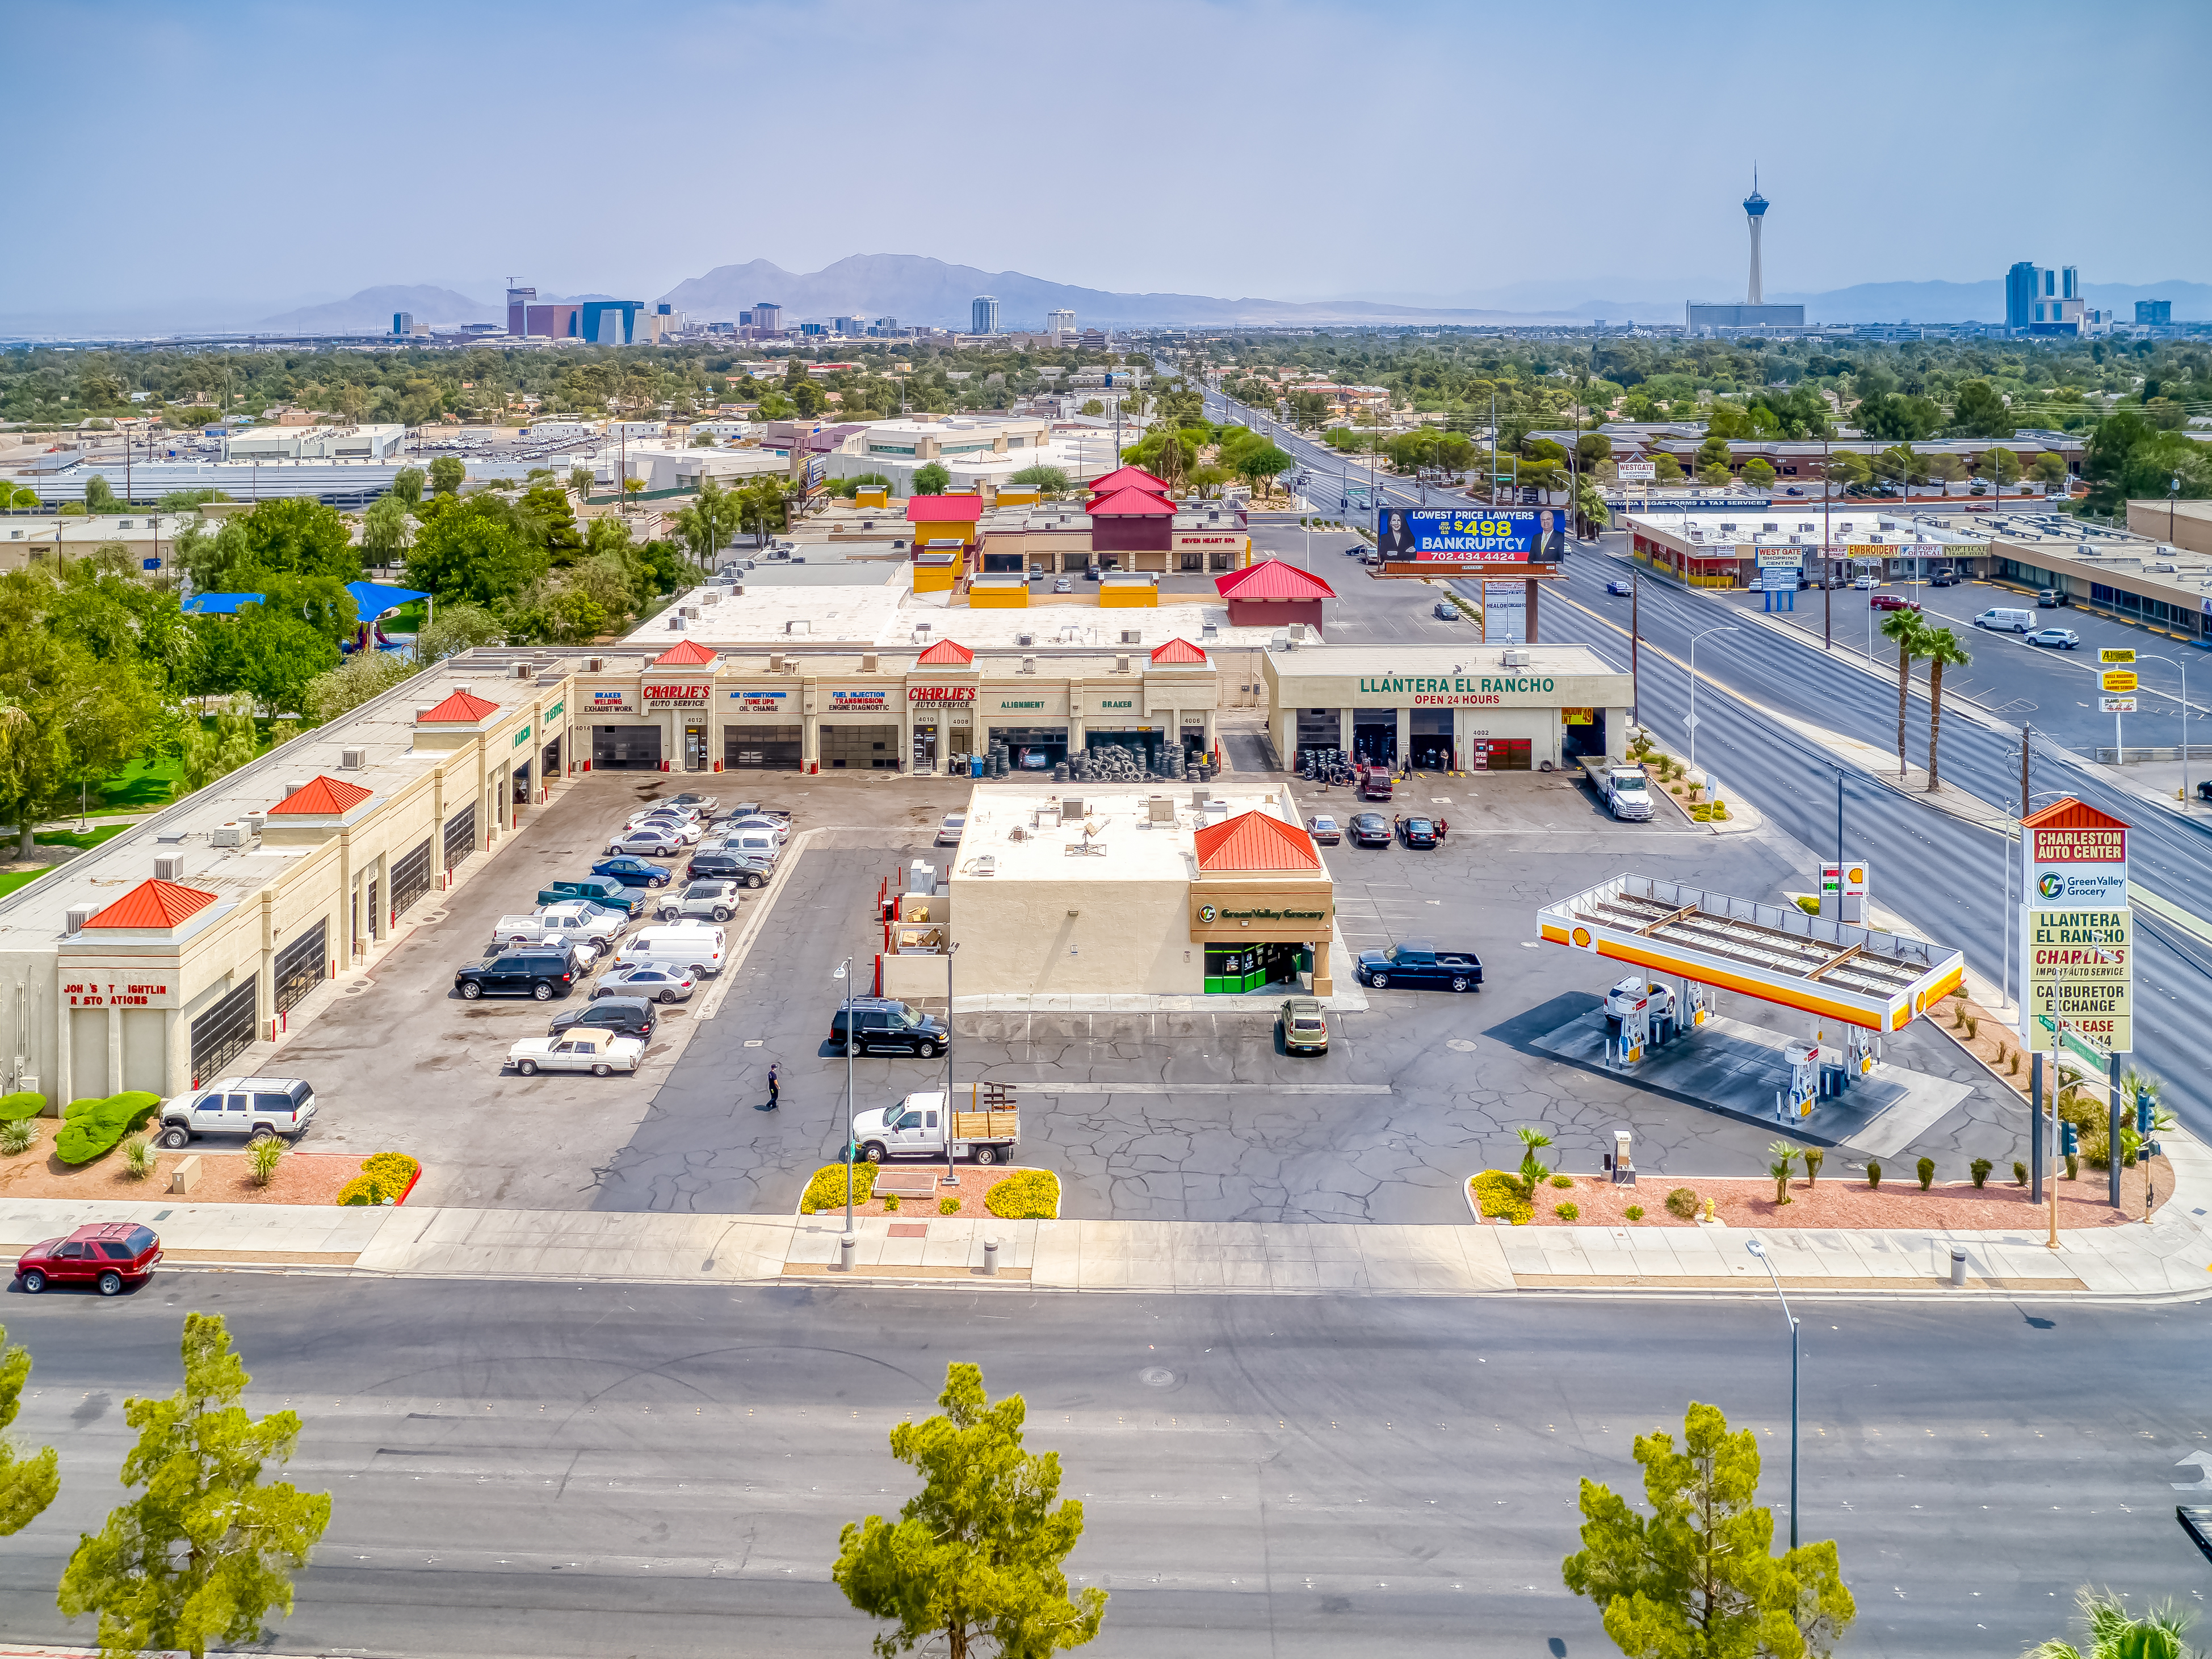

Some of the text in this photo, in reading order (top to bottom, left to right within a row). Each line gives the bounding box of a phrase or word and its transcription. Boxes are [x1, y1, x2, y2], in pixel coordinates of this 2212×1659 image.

[1487, 511, 1534, 520] LAWYERS
[1454, 520, 1511, 536] $498
[1422, 537, 1525, 550] BANKRUPTCY
[1849, 545, 1899, 555] EMBROIDERY
[1361, 678, 1554, 692] LLANTERA EL RANCHO
[644, 686, 710, 698] CHARLIE'S
[909, 688, 976, 700] CHARLIE'S
[1415, 695, 1500, 704] OPEN 24 HOURS
[2038, 833, 2121, 845] CHARLESTON
[2038, 846, 2122, 859] AUTO CENTER
[2067, 877, 2096, 885] Green
[2097, 876, 2123, 888] Valley
[2067, 887, 2106, 897] Grocery
[1222, 908, 1252, 918] Green
[1252, 908, 1283, 921] Valley
[1283, 908, 1325, 920] Grocery
[2041, 914, 2120, 926] LLANTERA
[2037, 930, 2055, 942] EL
[2036, 950, 2125, 965] CHARLIE'S
[2037, 986, 2124, 998] CARBURETOR
[2075, 1020, 2114, 1032] LEASE
